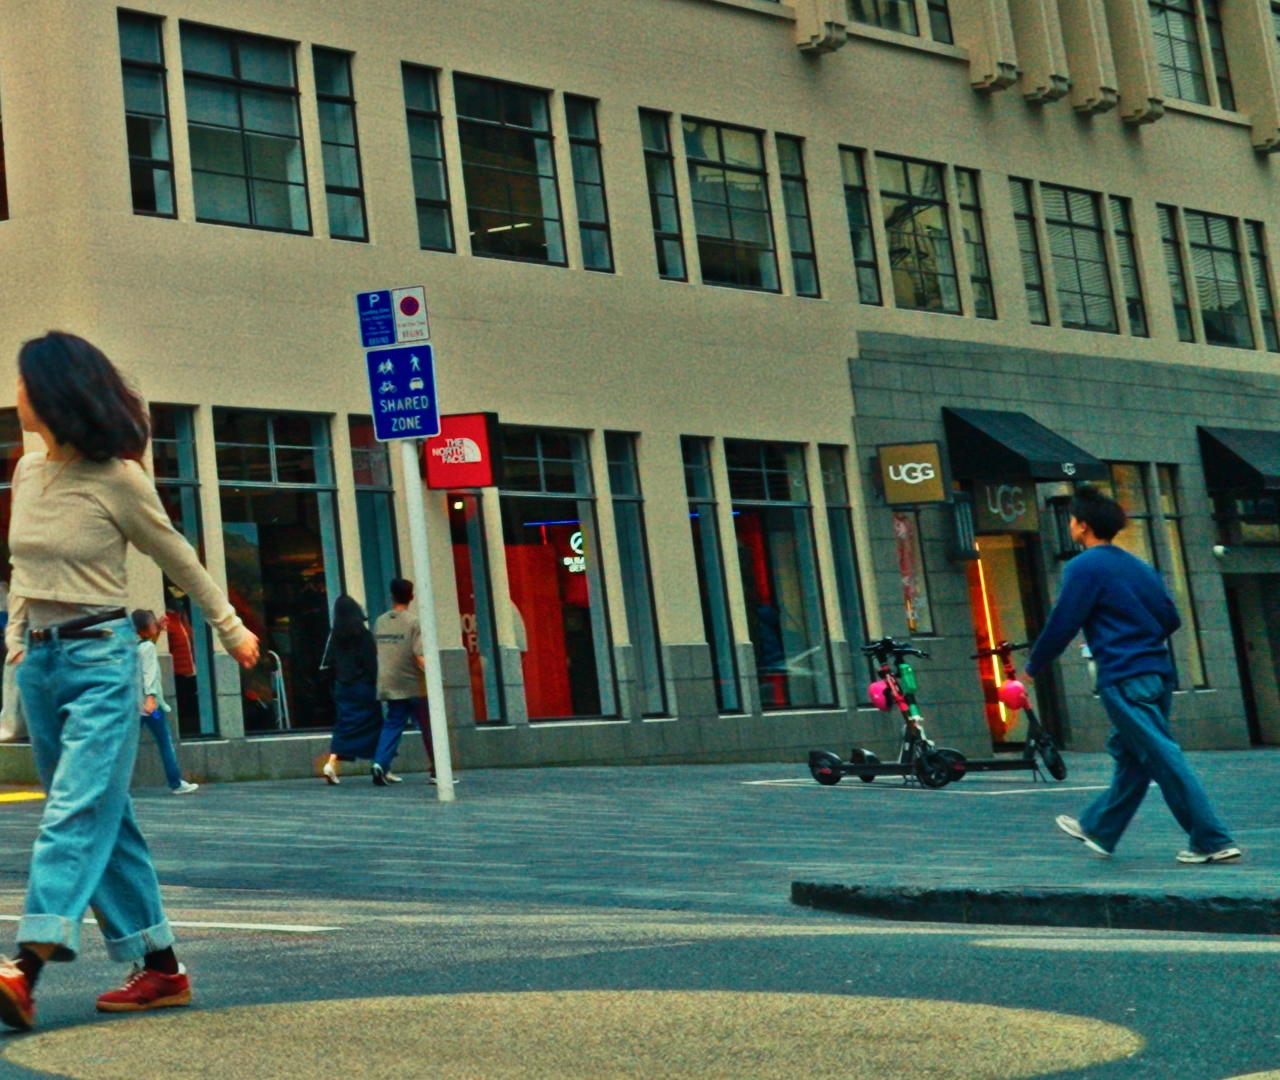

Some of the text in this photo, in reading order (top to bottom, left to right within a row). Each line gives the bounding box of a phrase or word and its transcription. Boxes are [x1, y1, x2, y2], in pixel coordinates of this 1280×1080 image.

[369, 294, 380, 308] P
[402, 329, 424, 338] BEGINS
[380, 395, 429, 413] SHARED
[391, 416, 422, 432] ZONE
[445, 438, 464, 448] THE
[432, 446, 464, 457] NORTH
[442, 455, 466, 464] FACE
[888, 462, 935, 485] UGG
[985, 483, 1027, 523] UGG
